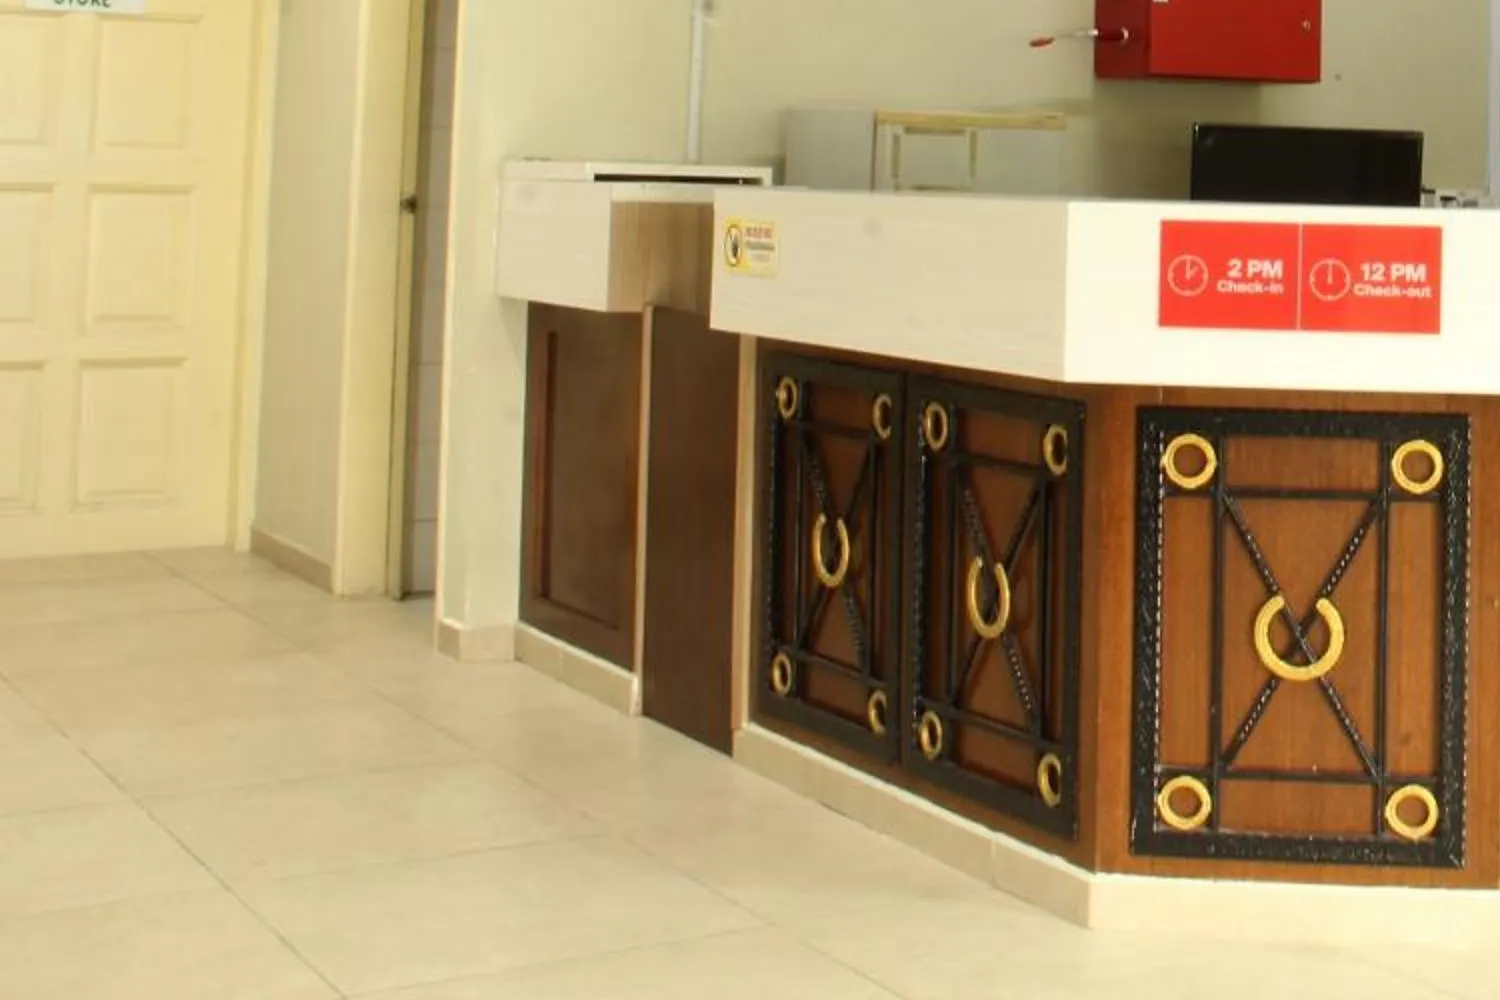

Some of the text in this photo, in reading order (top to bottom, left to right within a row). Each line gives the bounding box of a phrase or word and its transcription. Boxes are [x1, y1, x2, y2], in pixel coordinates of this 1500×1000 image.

[1226, 258, 1283, 279] 2 PM
[1360, 262, 1426, 282] 12 PM
[1217, 279, 1284, 294] Check-in
[1353, 283, 1431, 299] Check-out
